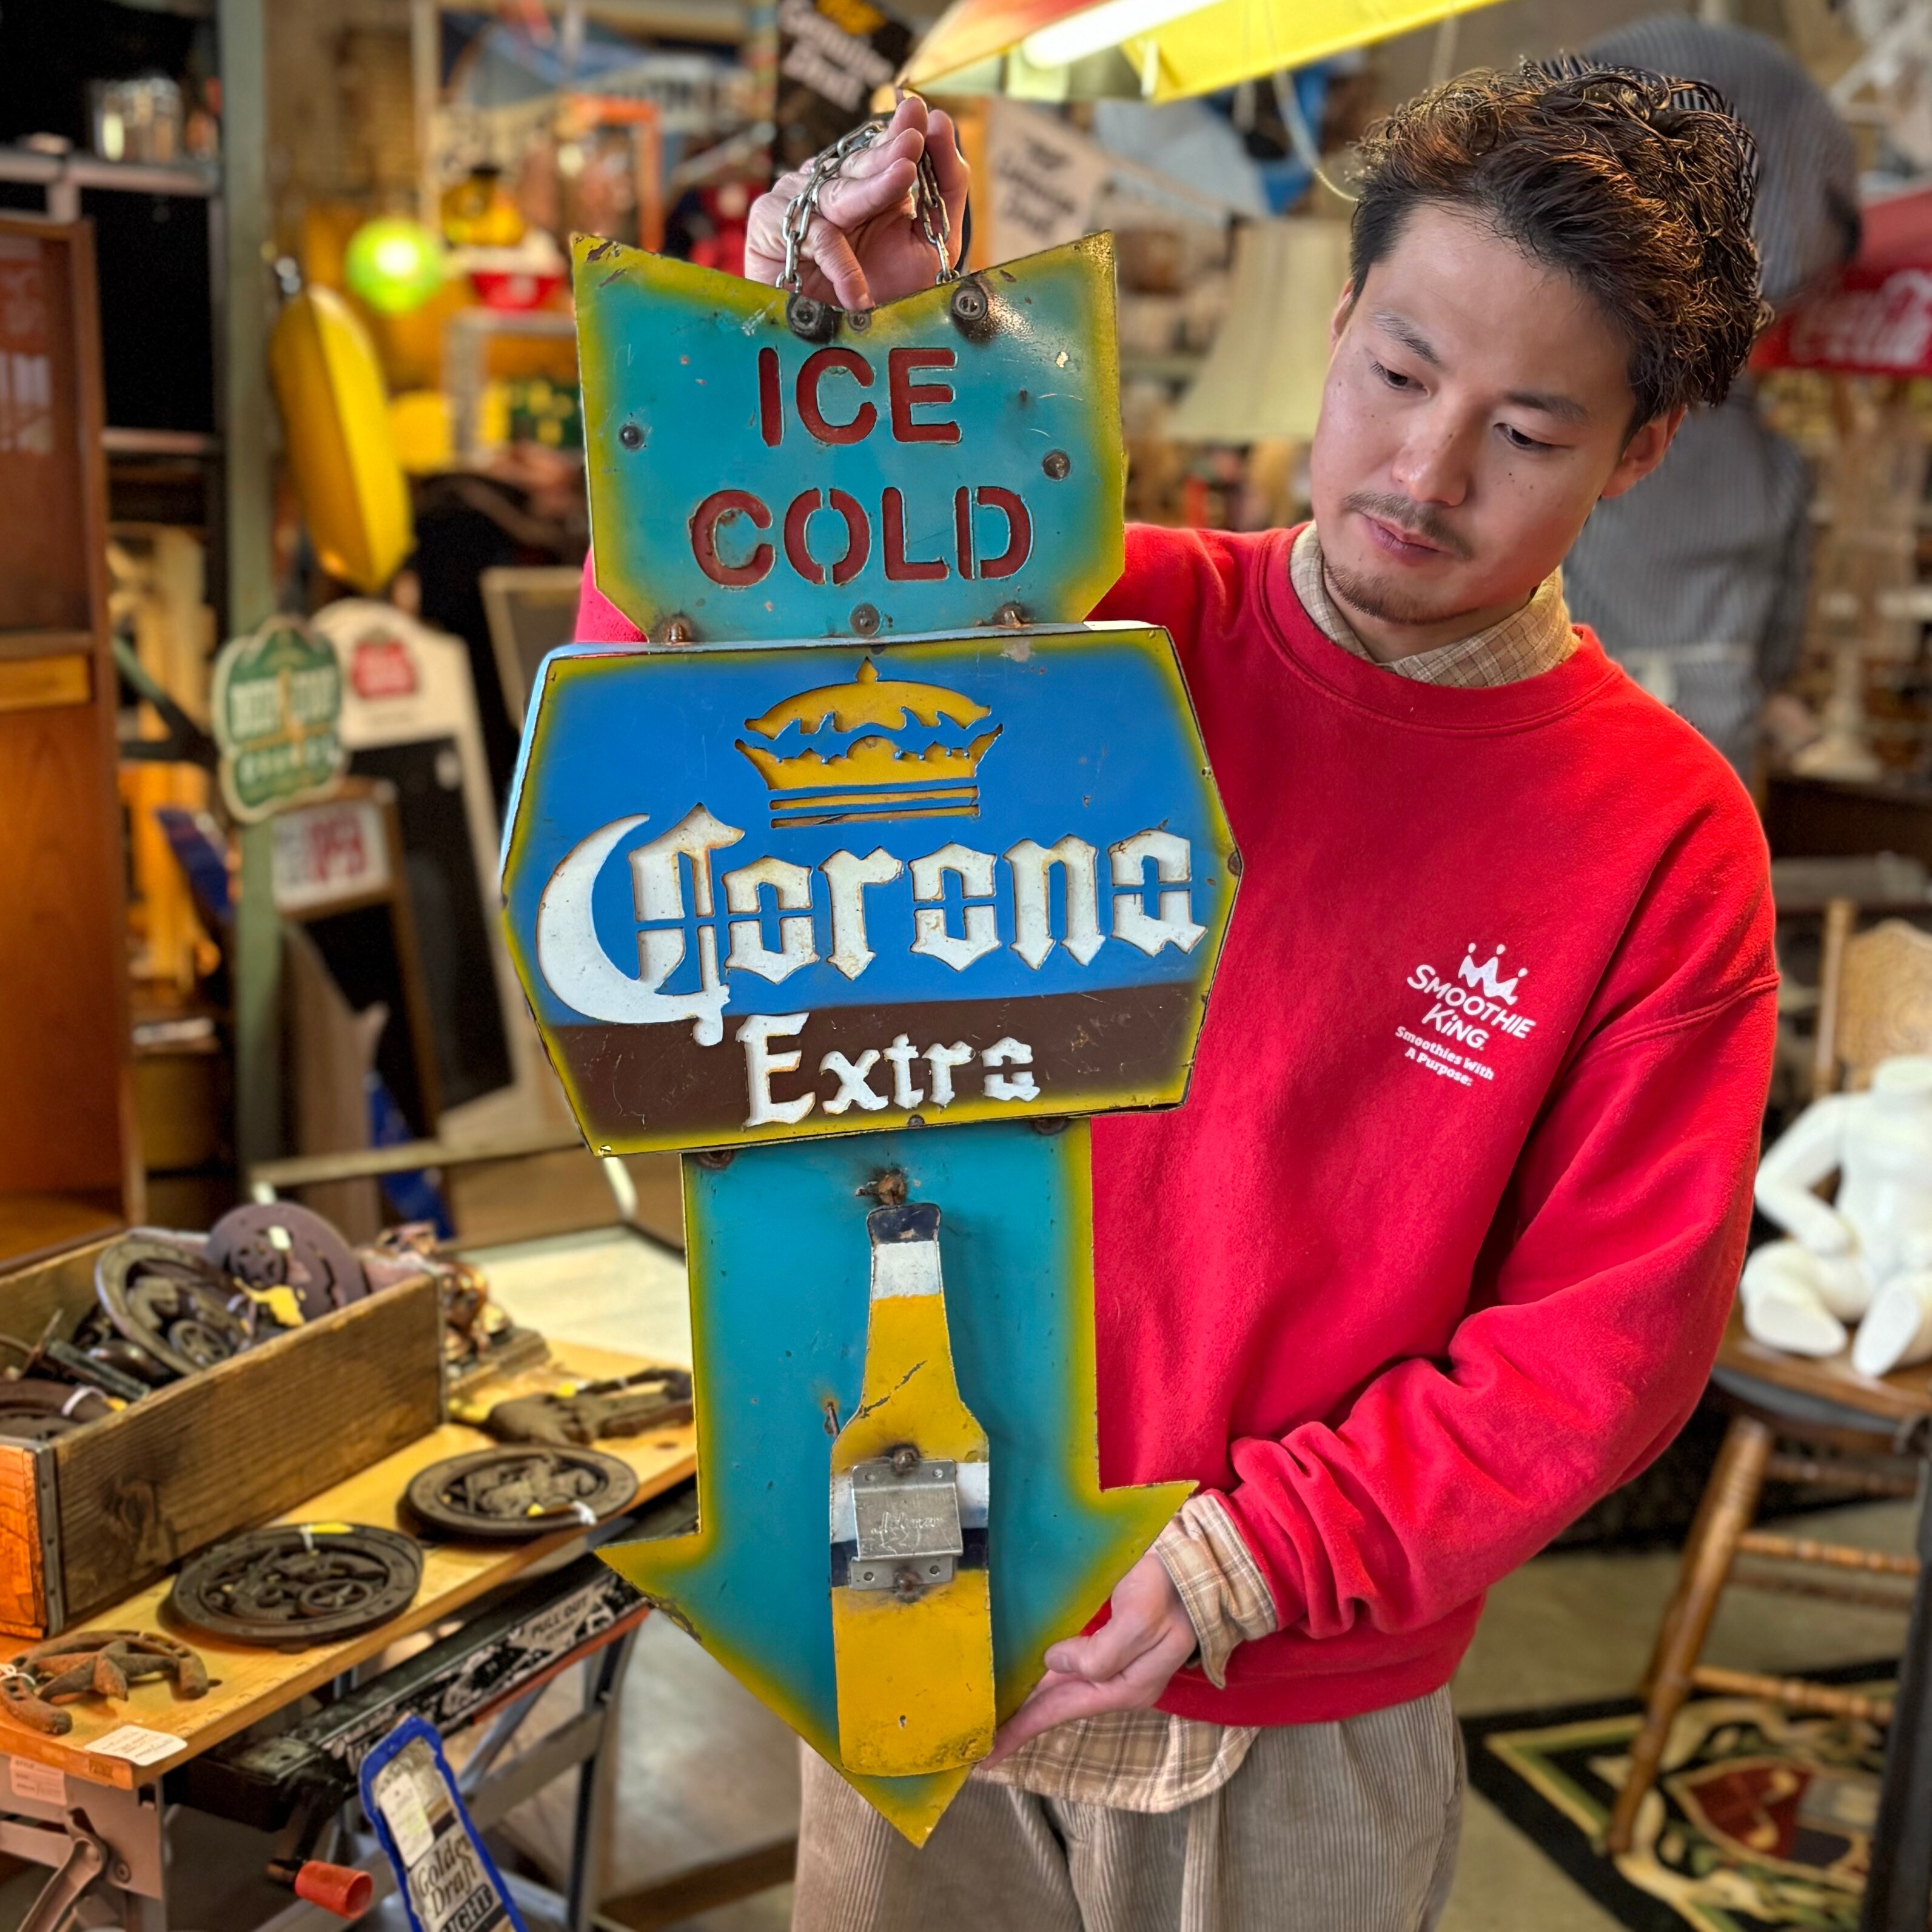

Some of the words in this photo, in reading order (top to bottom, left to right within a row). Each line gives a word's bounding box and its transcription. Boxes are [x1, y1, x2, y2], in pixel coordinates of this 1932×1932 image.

[758, 347, 962, 448] ICE
[690, 486, 1033, 587] COLD
[536, 802, 1209, 1046] Corona
[1407, 964, 1536, 1038] SMOOTHIE
[736, 1012, 1040, 1130] Extra
[1395, 1026, 1463, 1065] Smoothies
[1463, 1058, 1494, 1080] With
[1404, 1047, 1416, 1059] A
